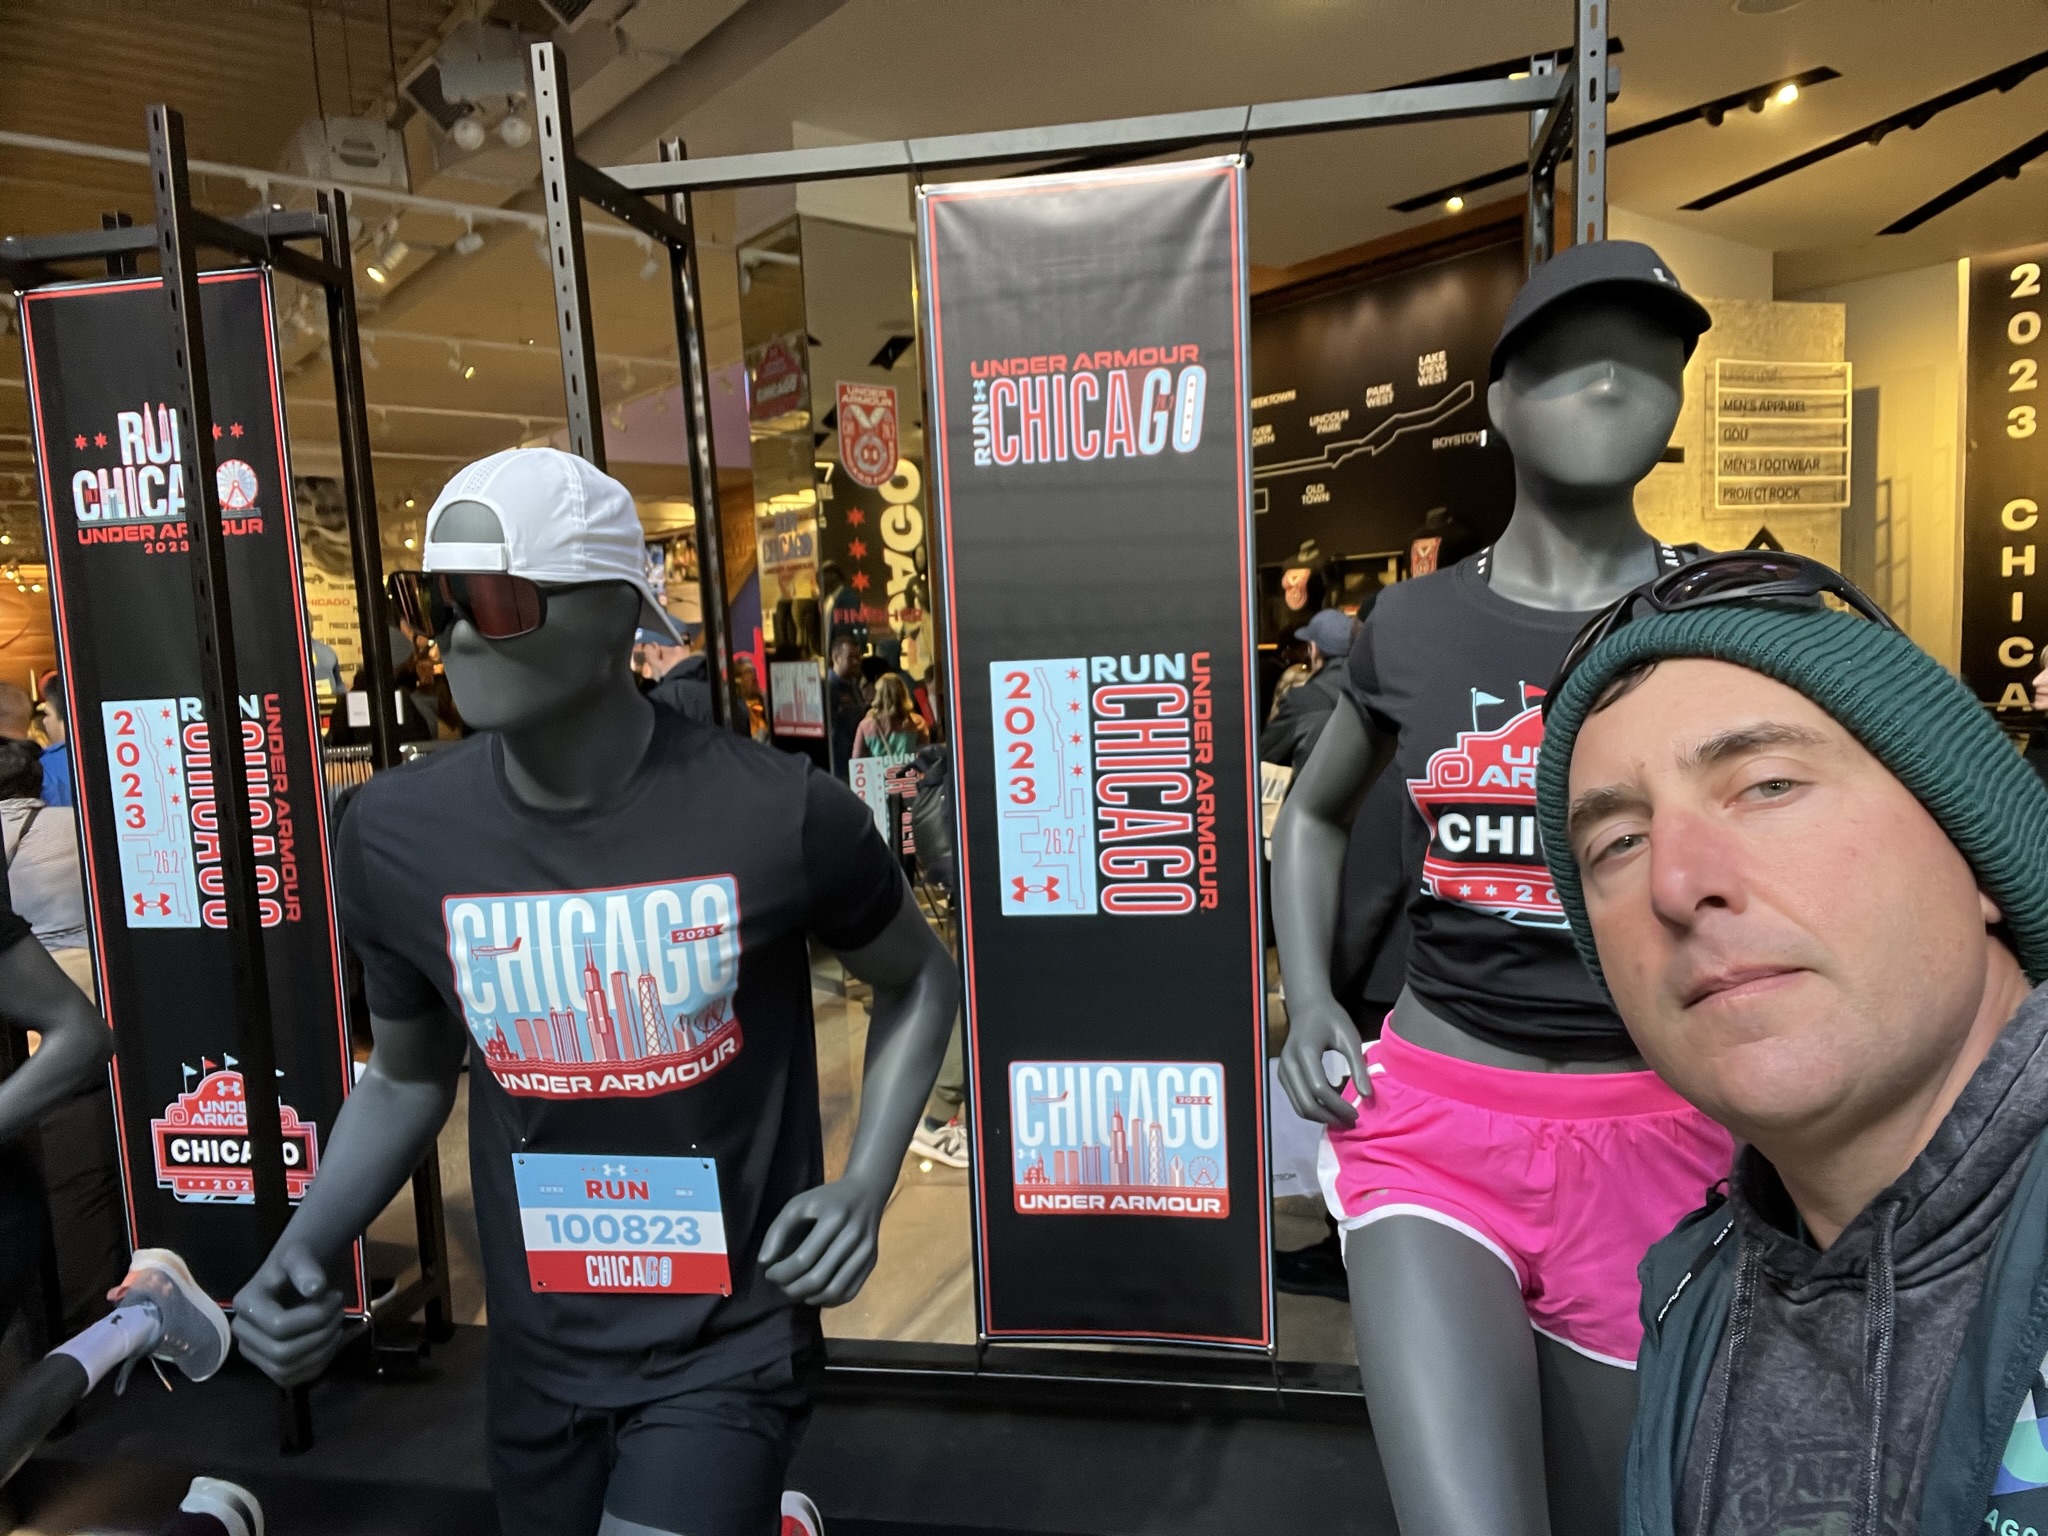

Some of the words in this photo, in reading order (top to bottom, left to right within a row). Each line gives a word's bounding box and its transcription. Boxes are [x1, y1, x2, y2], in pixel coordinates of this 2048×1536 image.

[970, 354, 1067, 379] UNDER
[1072, 343, 1199, 371] ARMOUR
[1419, 350, 1446, 367] LAKE
[2006, 262, 2041, 439] 2023
[989, 365, 1207, 466] CHICAGO
[1758, 400, 1807, 413] APPAREL
[972, 404, 992, 466] RUN
[1723, 487, 1767, 500] PROJECT
[1769, 487, 1800, 499] ROCK
[78, 524, 155, 545] UNDER
[145, 541, 190, 554] 2023
[1997, 498, 2040, 712] CHICA
[1091, 653, 1186, 683] RUN
[179, 694, 260, 722] RN
[1191, 652, 1215, 765] UNDER
[263, 693, 288, 794] UNDER
[1004, 670, 1037, 805] 2023
[113, 710, 147, 829] 2023
[1092, 682, 1196, 915] CHICAGO
[1043, 827, 1075, 854] 26.2
[1195, 768, 1219, 911] ARMOUR
[153, 850, 180, 874] 26.2
[274, 797, 302, 923] ARMOUR
[452, 883, 734, 1015] CHICAGO
[675, 926, 718, 942] 2023
[492, 1069, 592, 1094] UNDER
[598, 1036, 738, 1093] ARMOUR
[198, 1100, 247, 1113] UNDE
[1016, 1066, 1219, 1150] CHICAGO
[1178, 1096, 1207, 1105] 2023
[190, 1113, 247, 1126] ARMO
[212, 1179, 250, 1191] 202
[585, 1180, 649, 1201] RUN
[1019, 1194, 1106, 1210] UNDER
[1109, 1196, 1221, 1213] ARMOUR
[545, 1213, 702, 1246] 100823
[585, 1254, 673, 1288] CHICAGO
